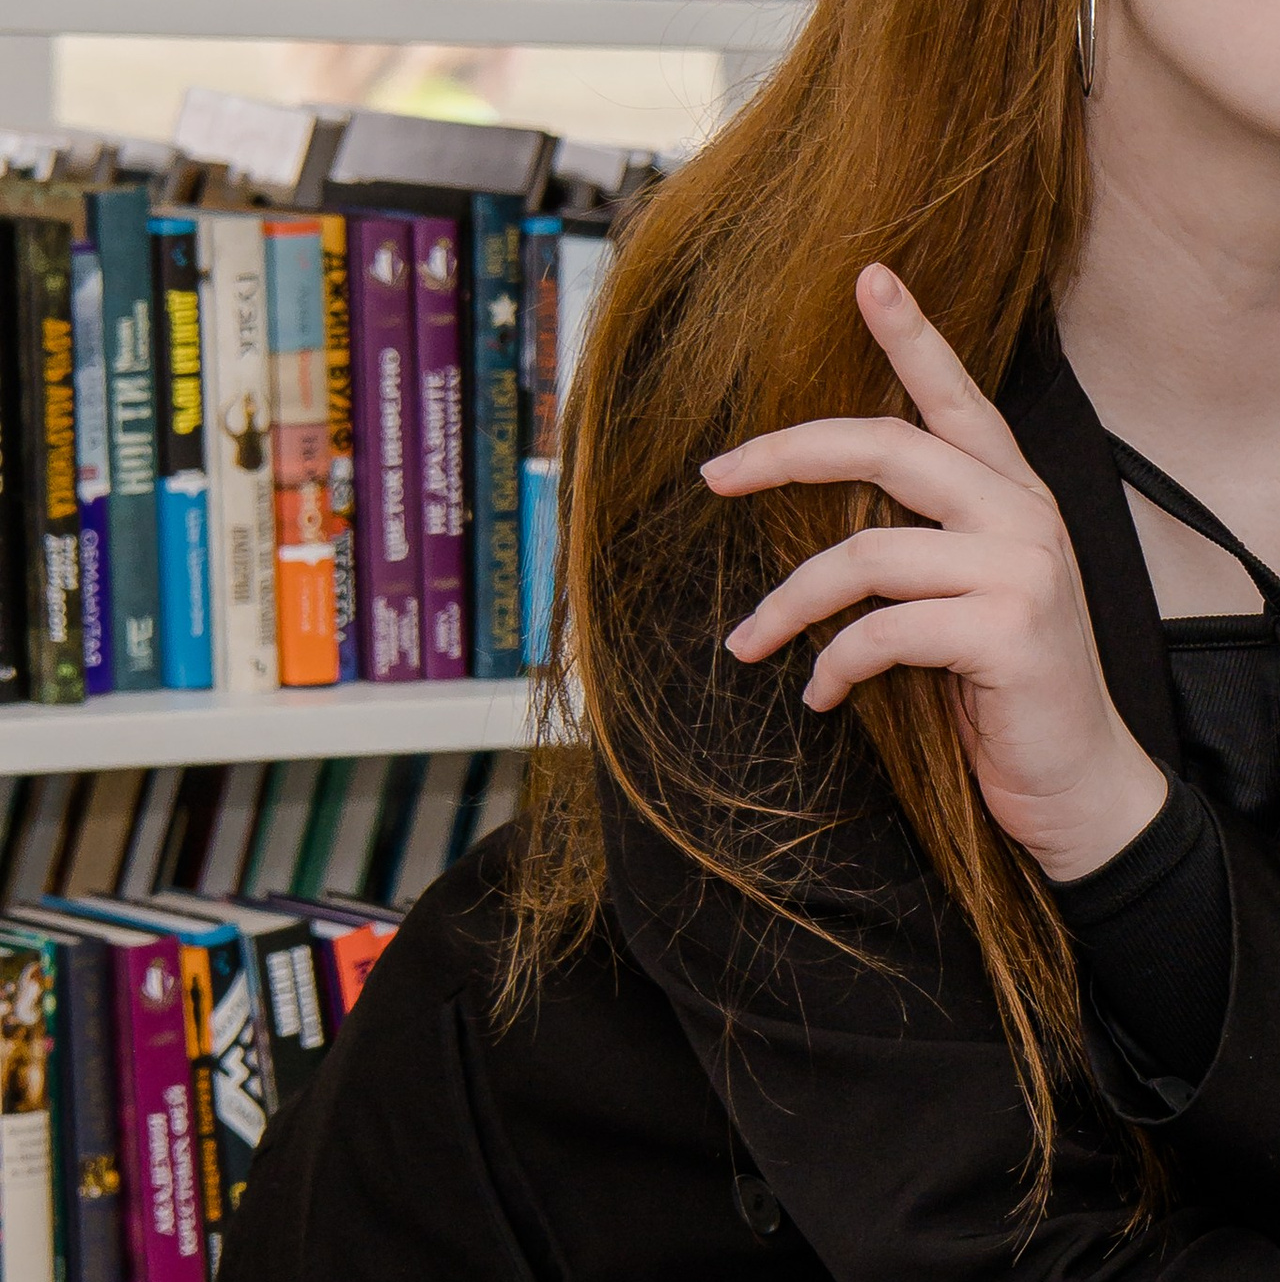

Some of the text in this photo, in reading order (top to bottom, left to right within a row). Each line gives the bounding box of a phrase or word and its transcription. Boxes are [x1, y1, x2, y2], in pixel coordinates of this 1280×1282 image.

[324, 249, 351, 361] ДЖИН
[111, 371, 155, 496] НОГТИ
[81, 529, 102, 668] ОБМАНУТАЯ
[490, 519, 519, 650] КОРОЛЕВА
[147, 1112, 175, 1236] АКАДЕМИЯ
